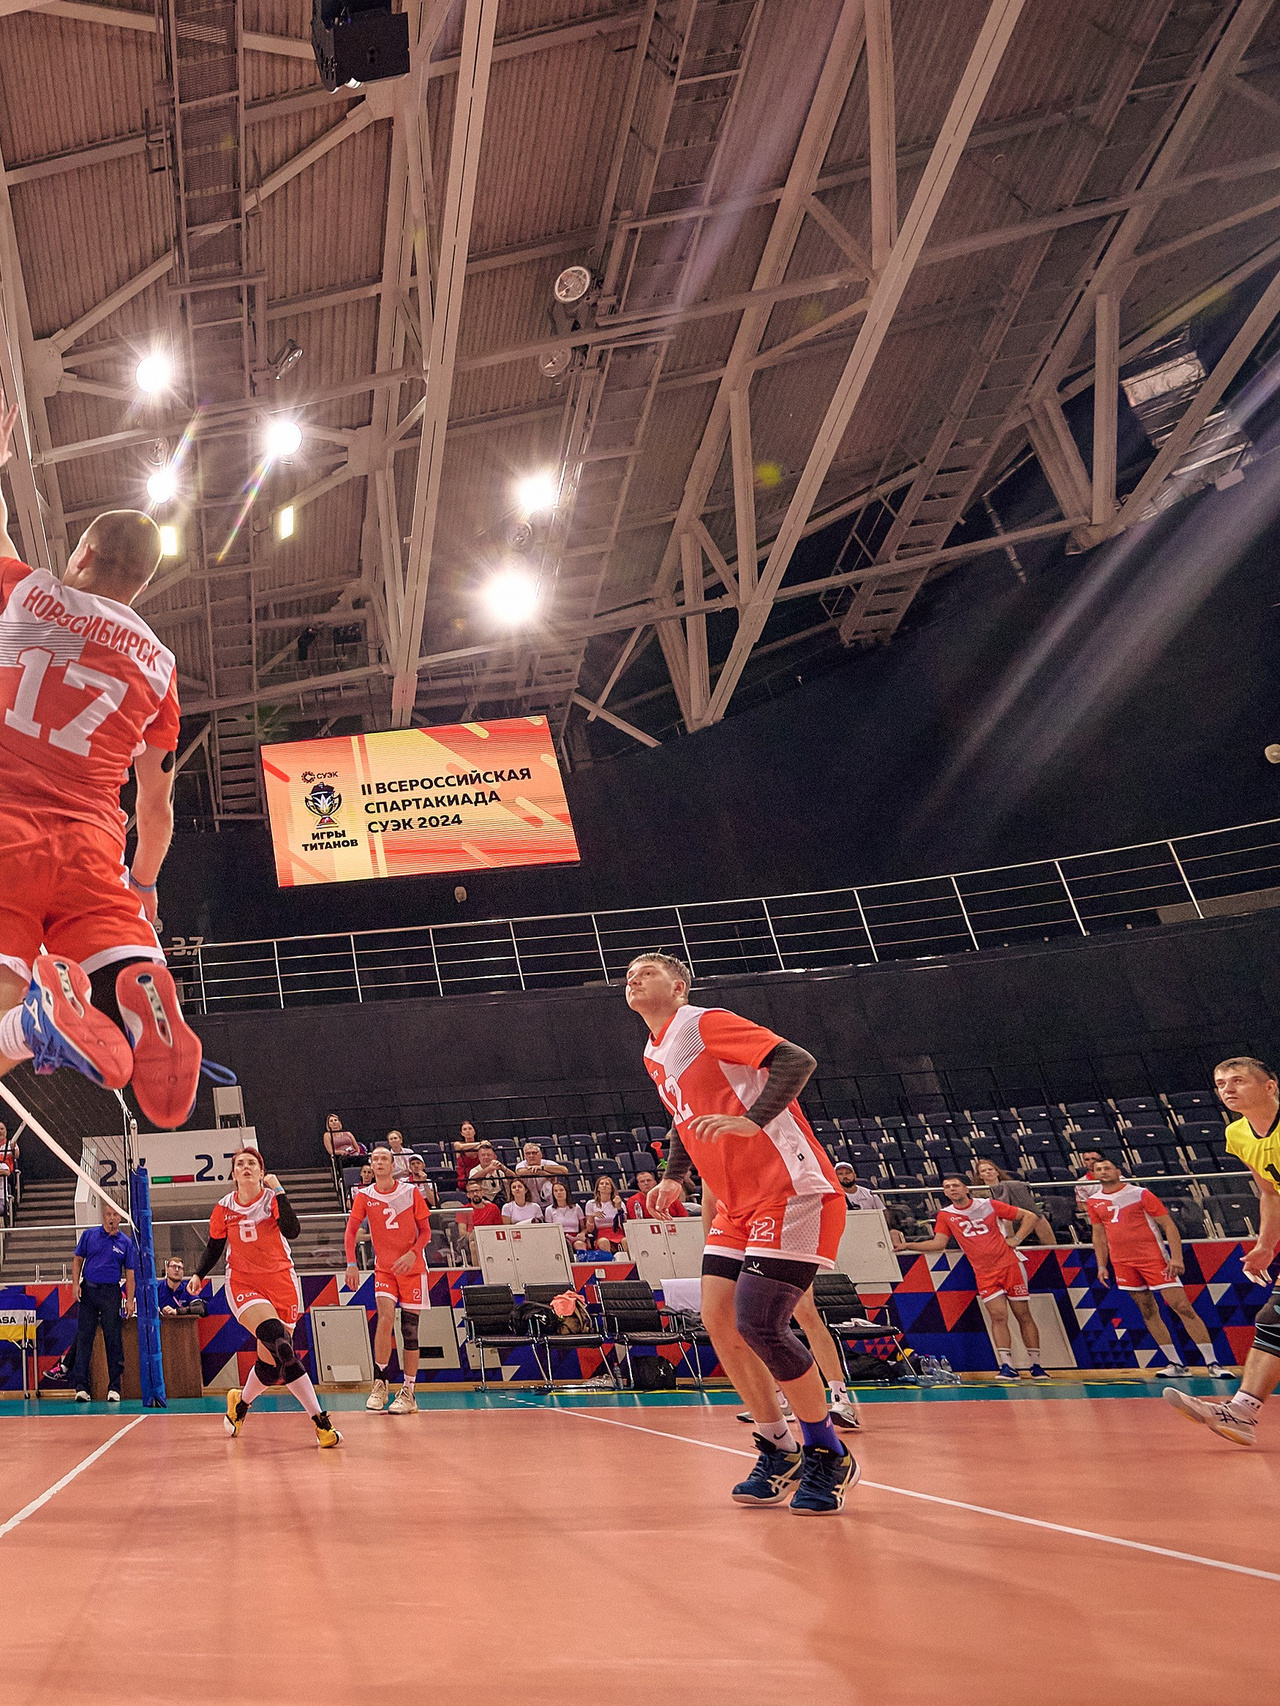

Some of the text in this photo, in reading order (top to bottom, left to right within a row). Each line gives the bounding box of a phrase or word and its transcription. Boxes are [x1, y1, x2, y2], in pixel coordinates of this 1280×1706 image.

[22, 585, 161, 672] НОВОСИБИРСК
[5, 646, 129, 757] 17
[316, 771, 339, 780] СУЭК
[375, 767, 532, 795] ВСЕРОССИЙСКАЯ
[364, 790, 502, 815] СПАРТАКИАДА
[367, 814, 463, 834] СУЭК 2024
[302, 839, 359, 852] ТИТАНОВ
[311, 830, 346, 841] ИГРЫ
[658, 1075, 694, 1126] 12
[383, 1208, 400, 1229] 2
[1106, 1205, 1120, 1223] 7
[958, 1218, 989, 1238] 25
[412, 1288, 422, 1301] 2
